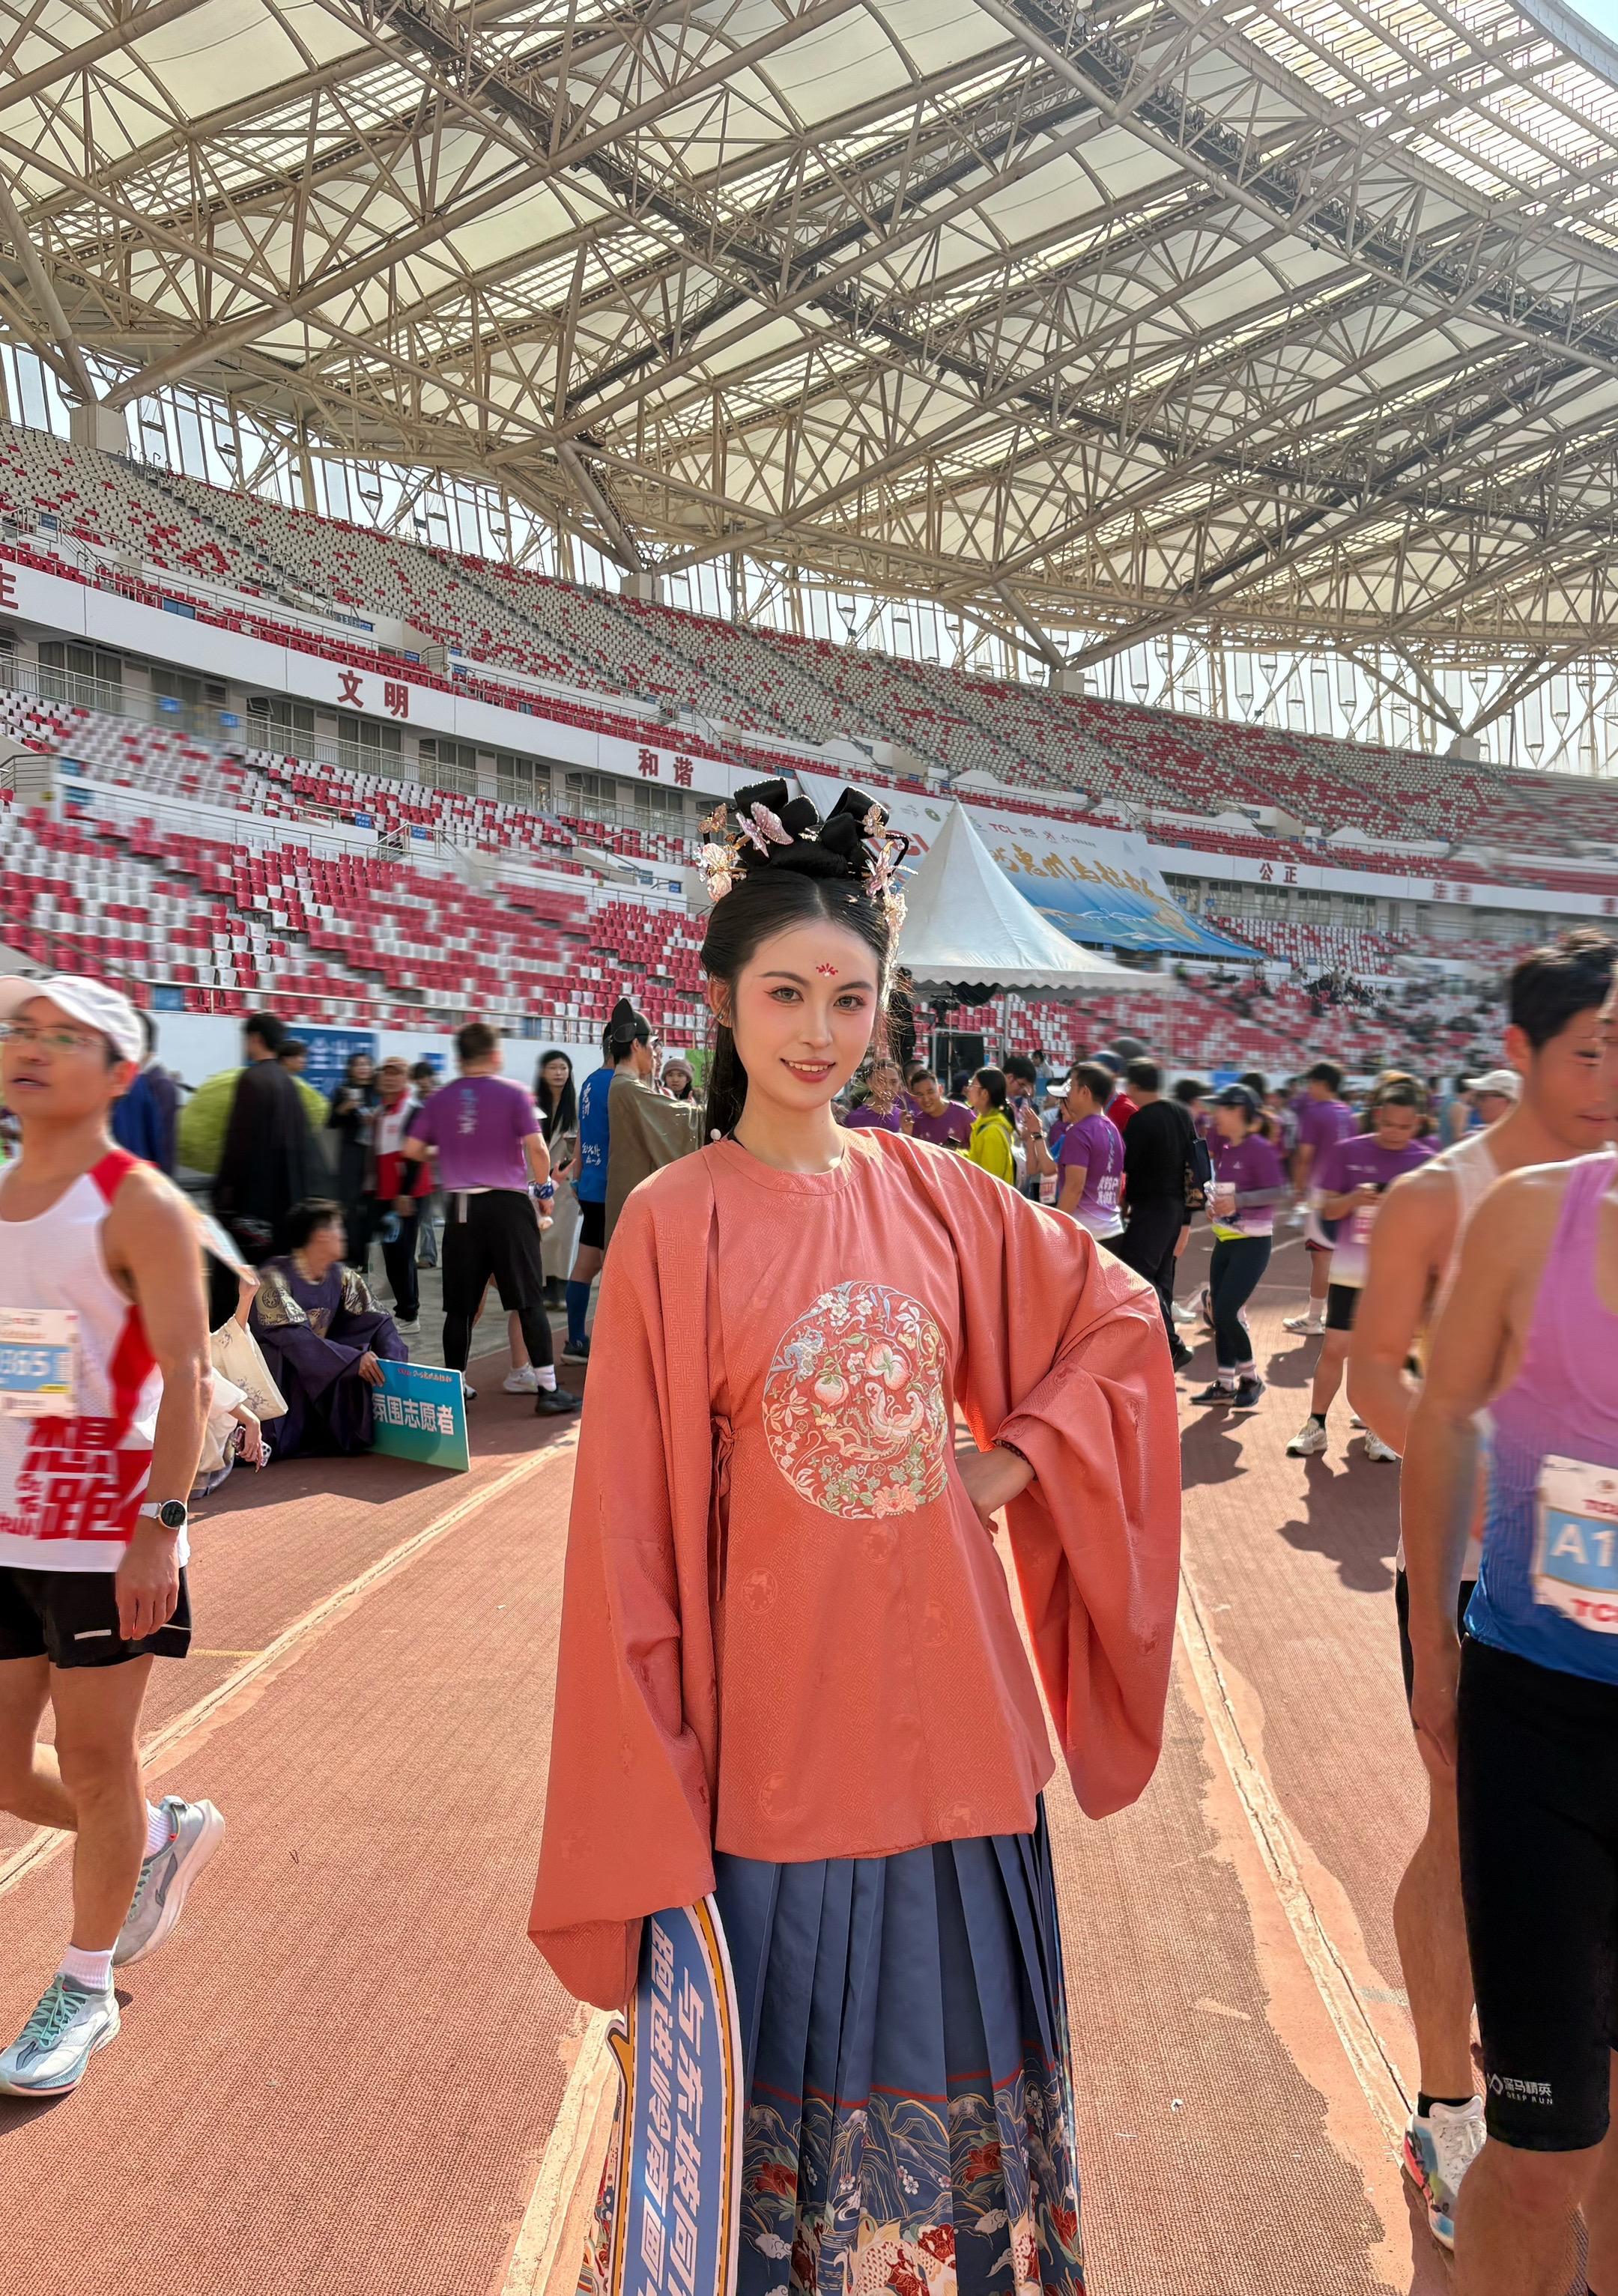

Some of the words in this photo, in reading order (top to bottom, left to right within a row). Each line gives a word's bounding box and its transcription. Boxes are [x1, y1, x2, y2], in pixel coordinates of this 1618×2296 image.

[337, 669, 409, 718] 文明
[637, 748, 694, 788] 和谐
[988, 822, 1017, 835] TCL
[1258, 862, 1298, 884] 公正
[372, 1393, 455, 1436] 氛围志愿者
